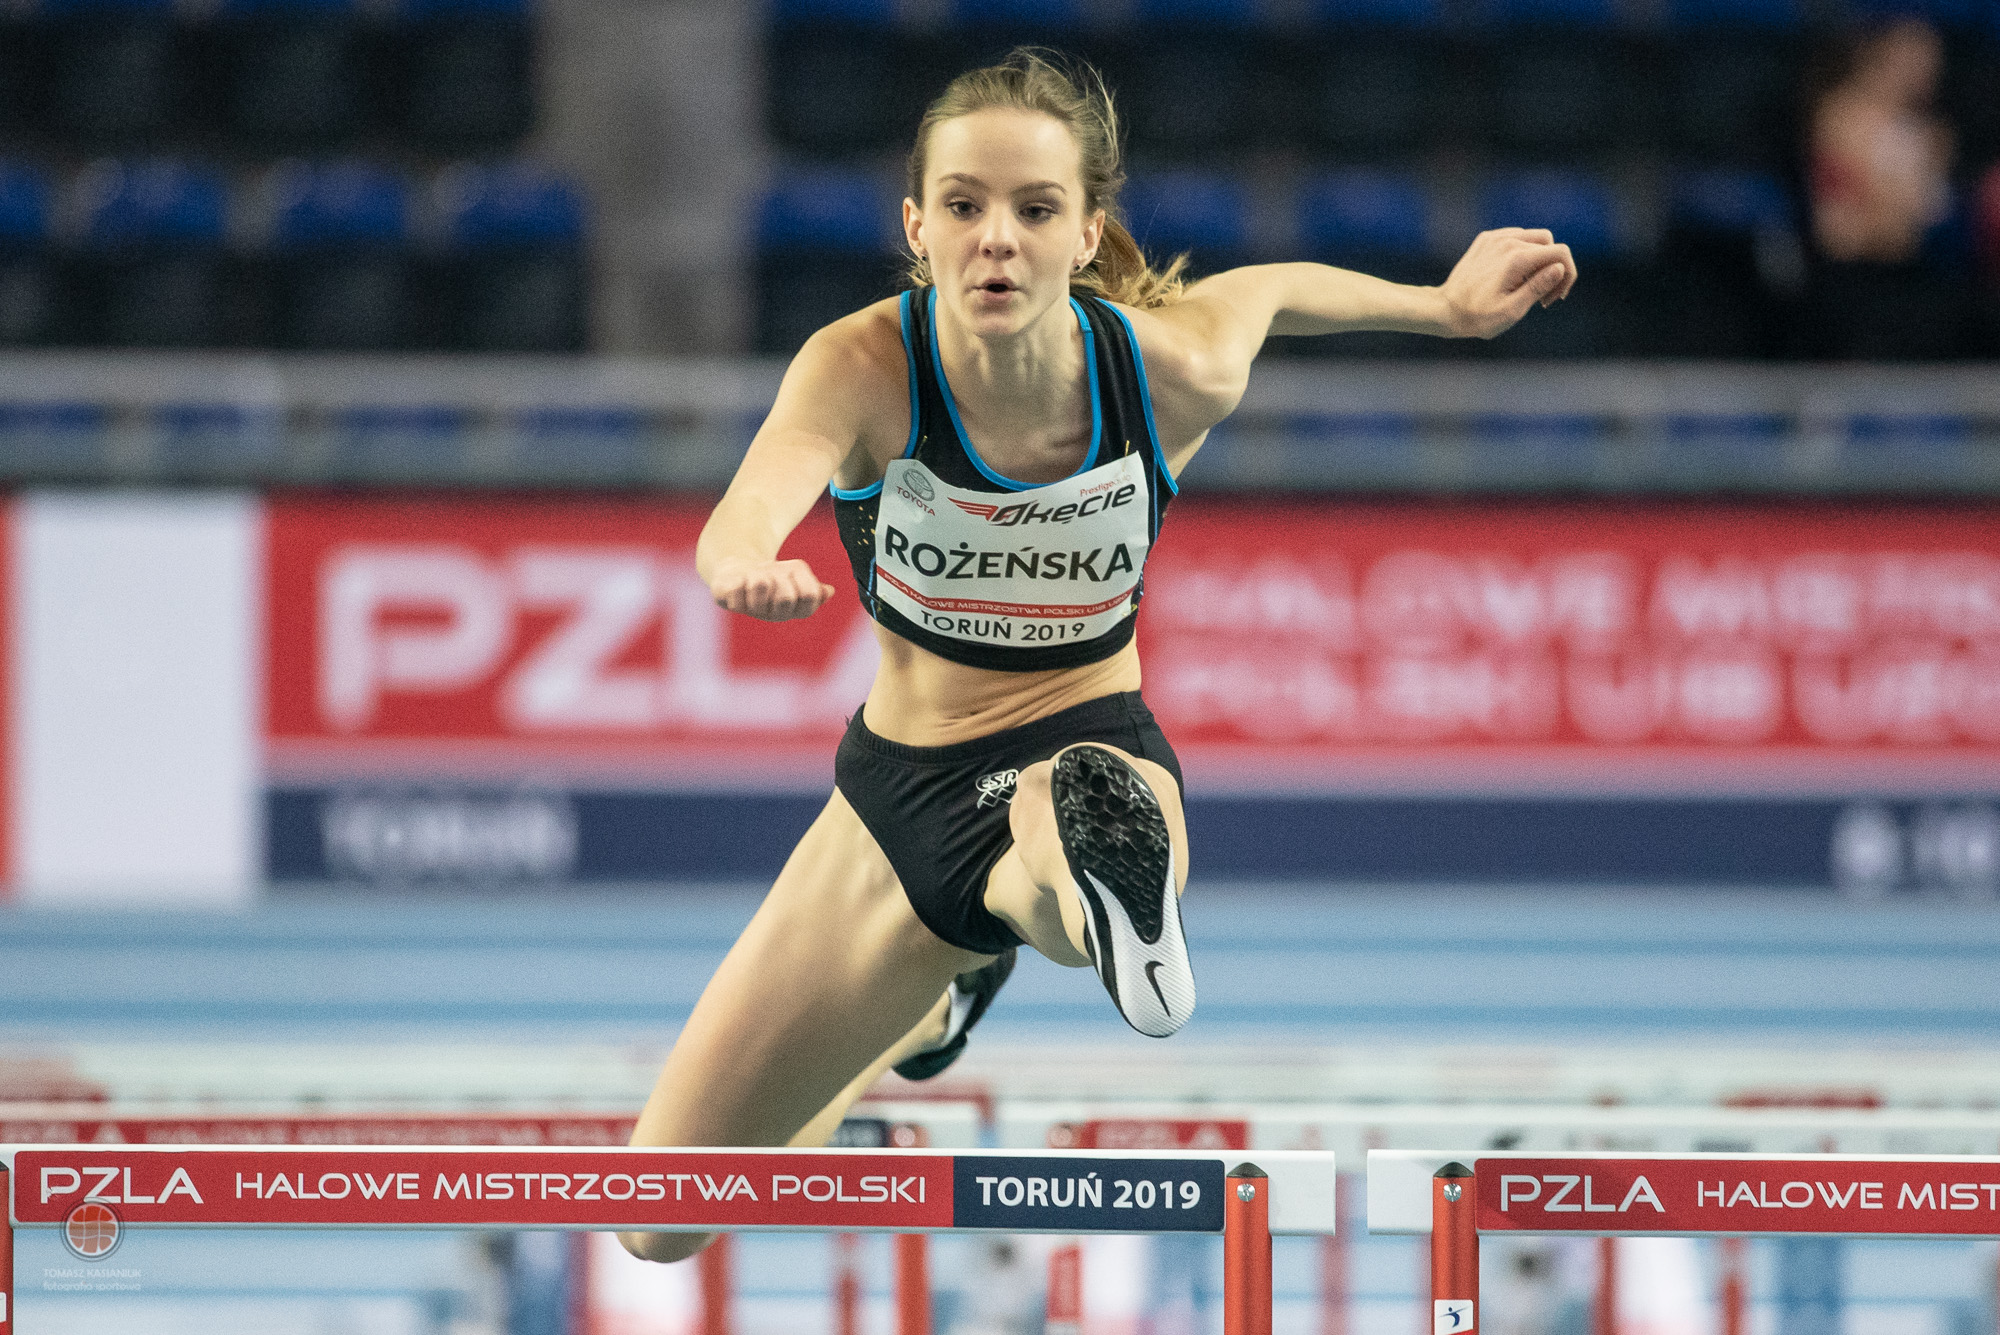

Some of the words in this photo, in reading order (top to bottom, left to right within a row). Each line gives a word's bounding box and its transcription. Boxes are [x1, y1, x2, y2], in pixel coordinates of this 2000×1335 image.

[896, 485, 936, 516] TOYOTA
[884, 524, 1134, 582] ROŻEŃSKA
[921, 609, 1012, 640] TORUŃ
[1020, 621, 1086, 641] 2019
[958, 601, 1041, 614] MISTRZOSTWA
[1043, 607, 1085, 615] POLSKI
[317, 543, 880, 735] PZL
[40, 1166, 204, 1205] PZLA
[235, 1172, 420, 1200] HALOWE
[433, 1172, 759, 1201] MISTRZOSTWA
[772, 1174, 926, 1203] POLSKI
[975, 1171, 1103, 1208] TORUŃ
[1112, 1179, 1201, 1210] 2019
[1500, 1174, 1666, 1213] PZLA
[1697, 1180, 1884, 1210] HALOWE
[1896, 1182, 2000, 1211] MIST
